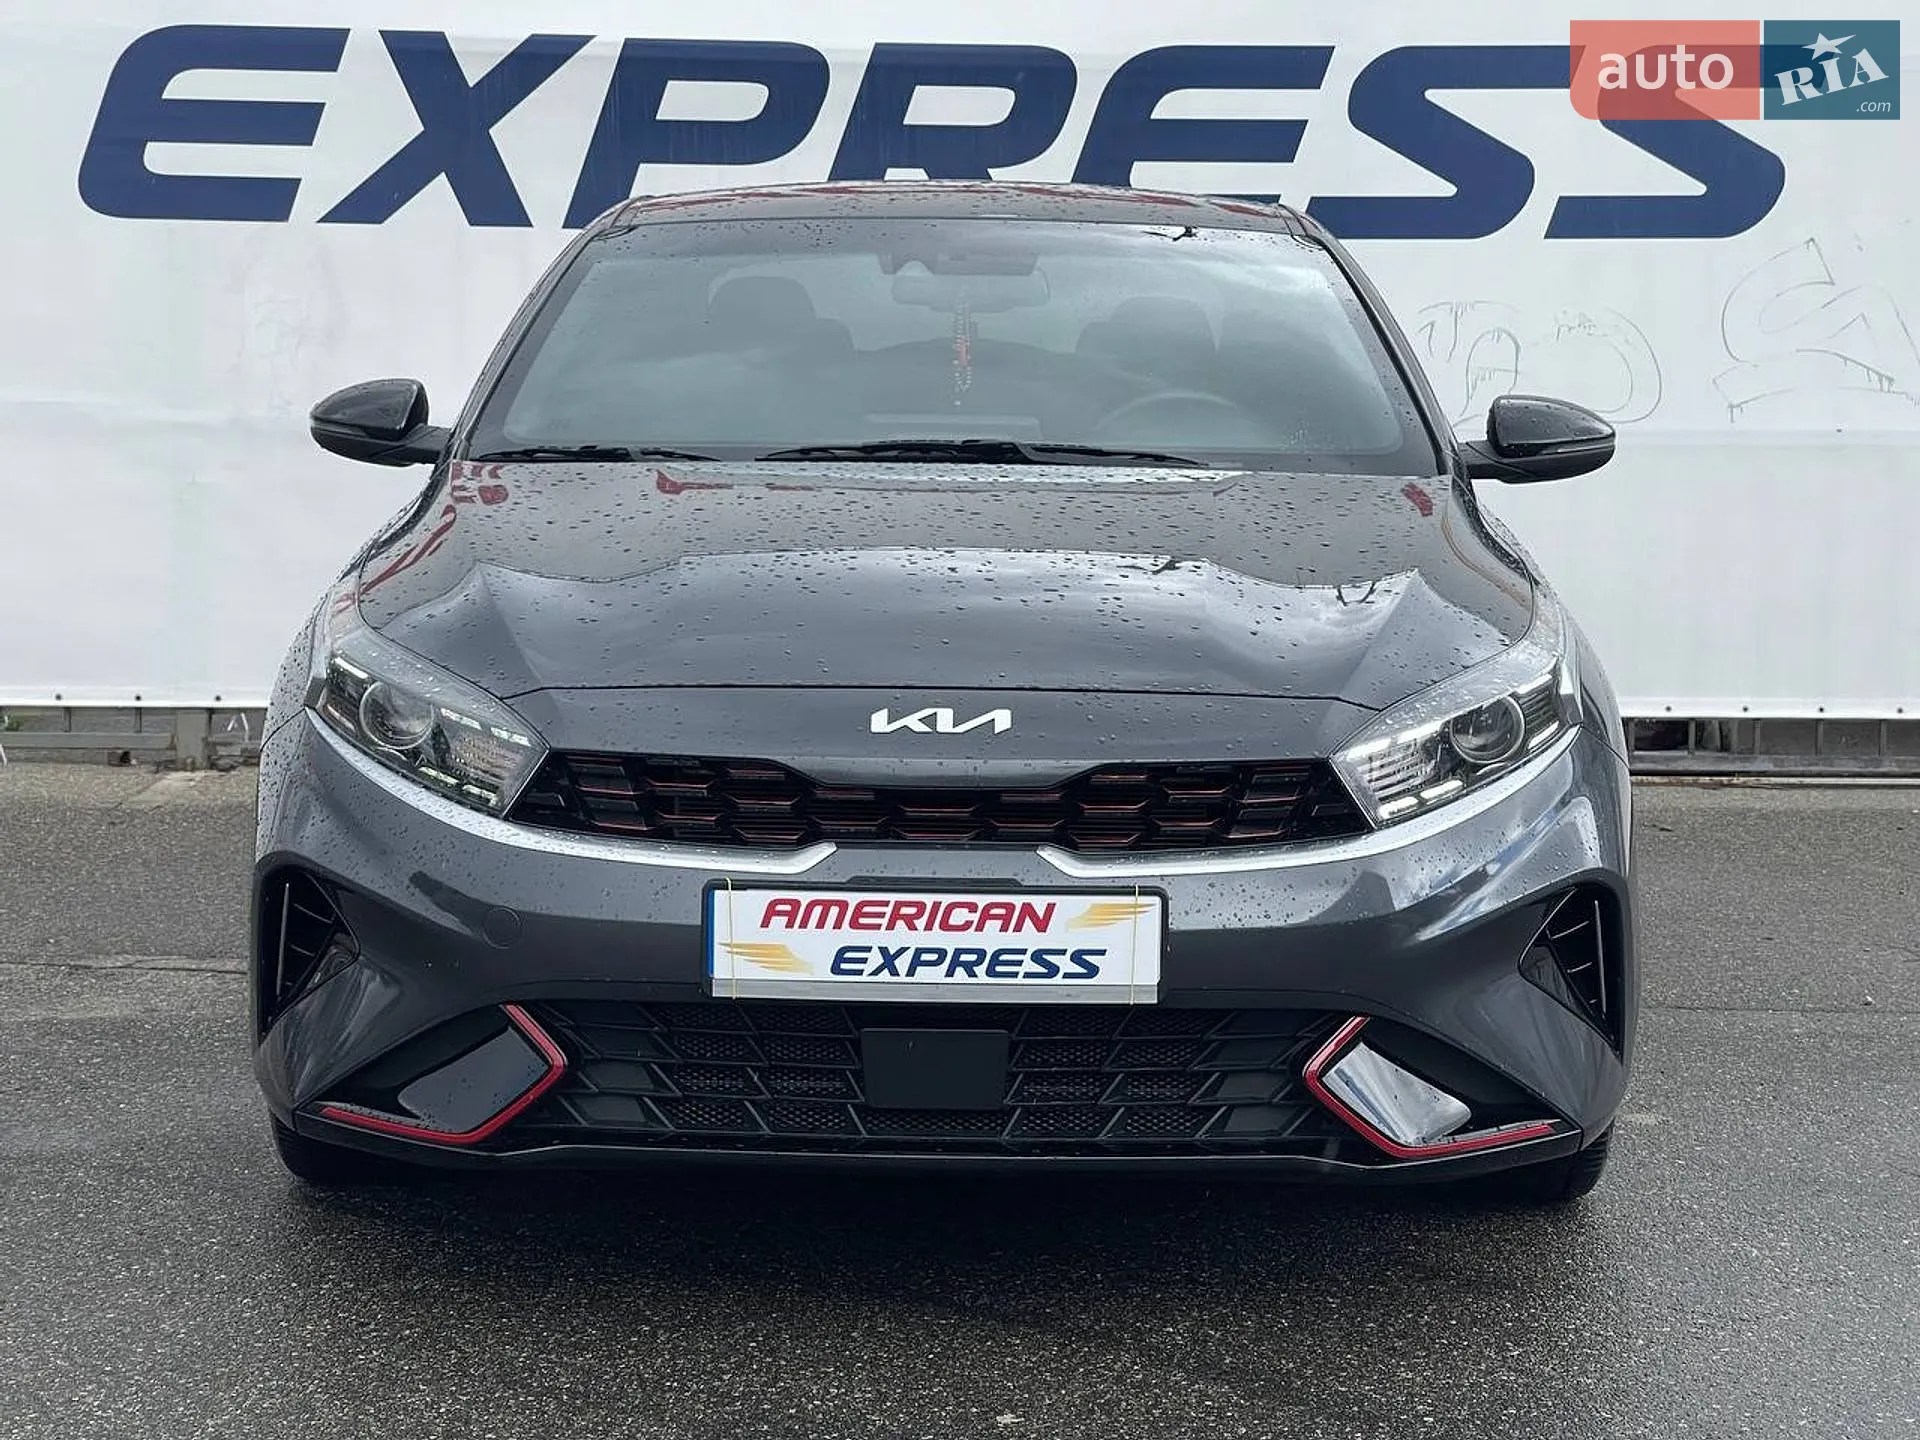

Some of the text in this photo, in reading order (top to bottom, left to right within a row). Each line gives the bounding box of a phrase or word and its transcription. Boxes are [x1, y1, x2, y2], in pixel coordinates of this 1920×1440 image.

[78, 24, 1832, 240] EXPRESS
[759, 897, 1057, 934] AMERICAN
[829, 945, 1108, 980] EXPRESS
